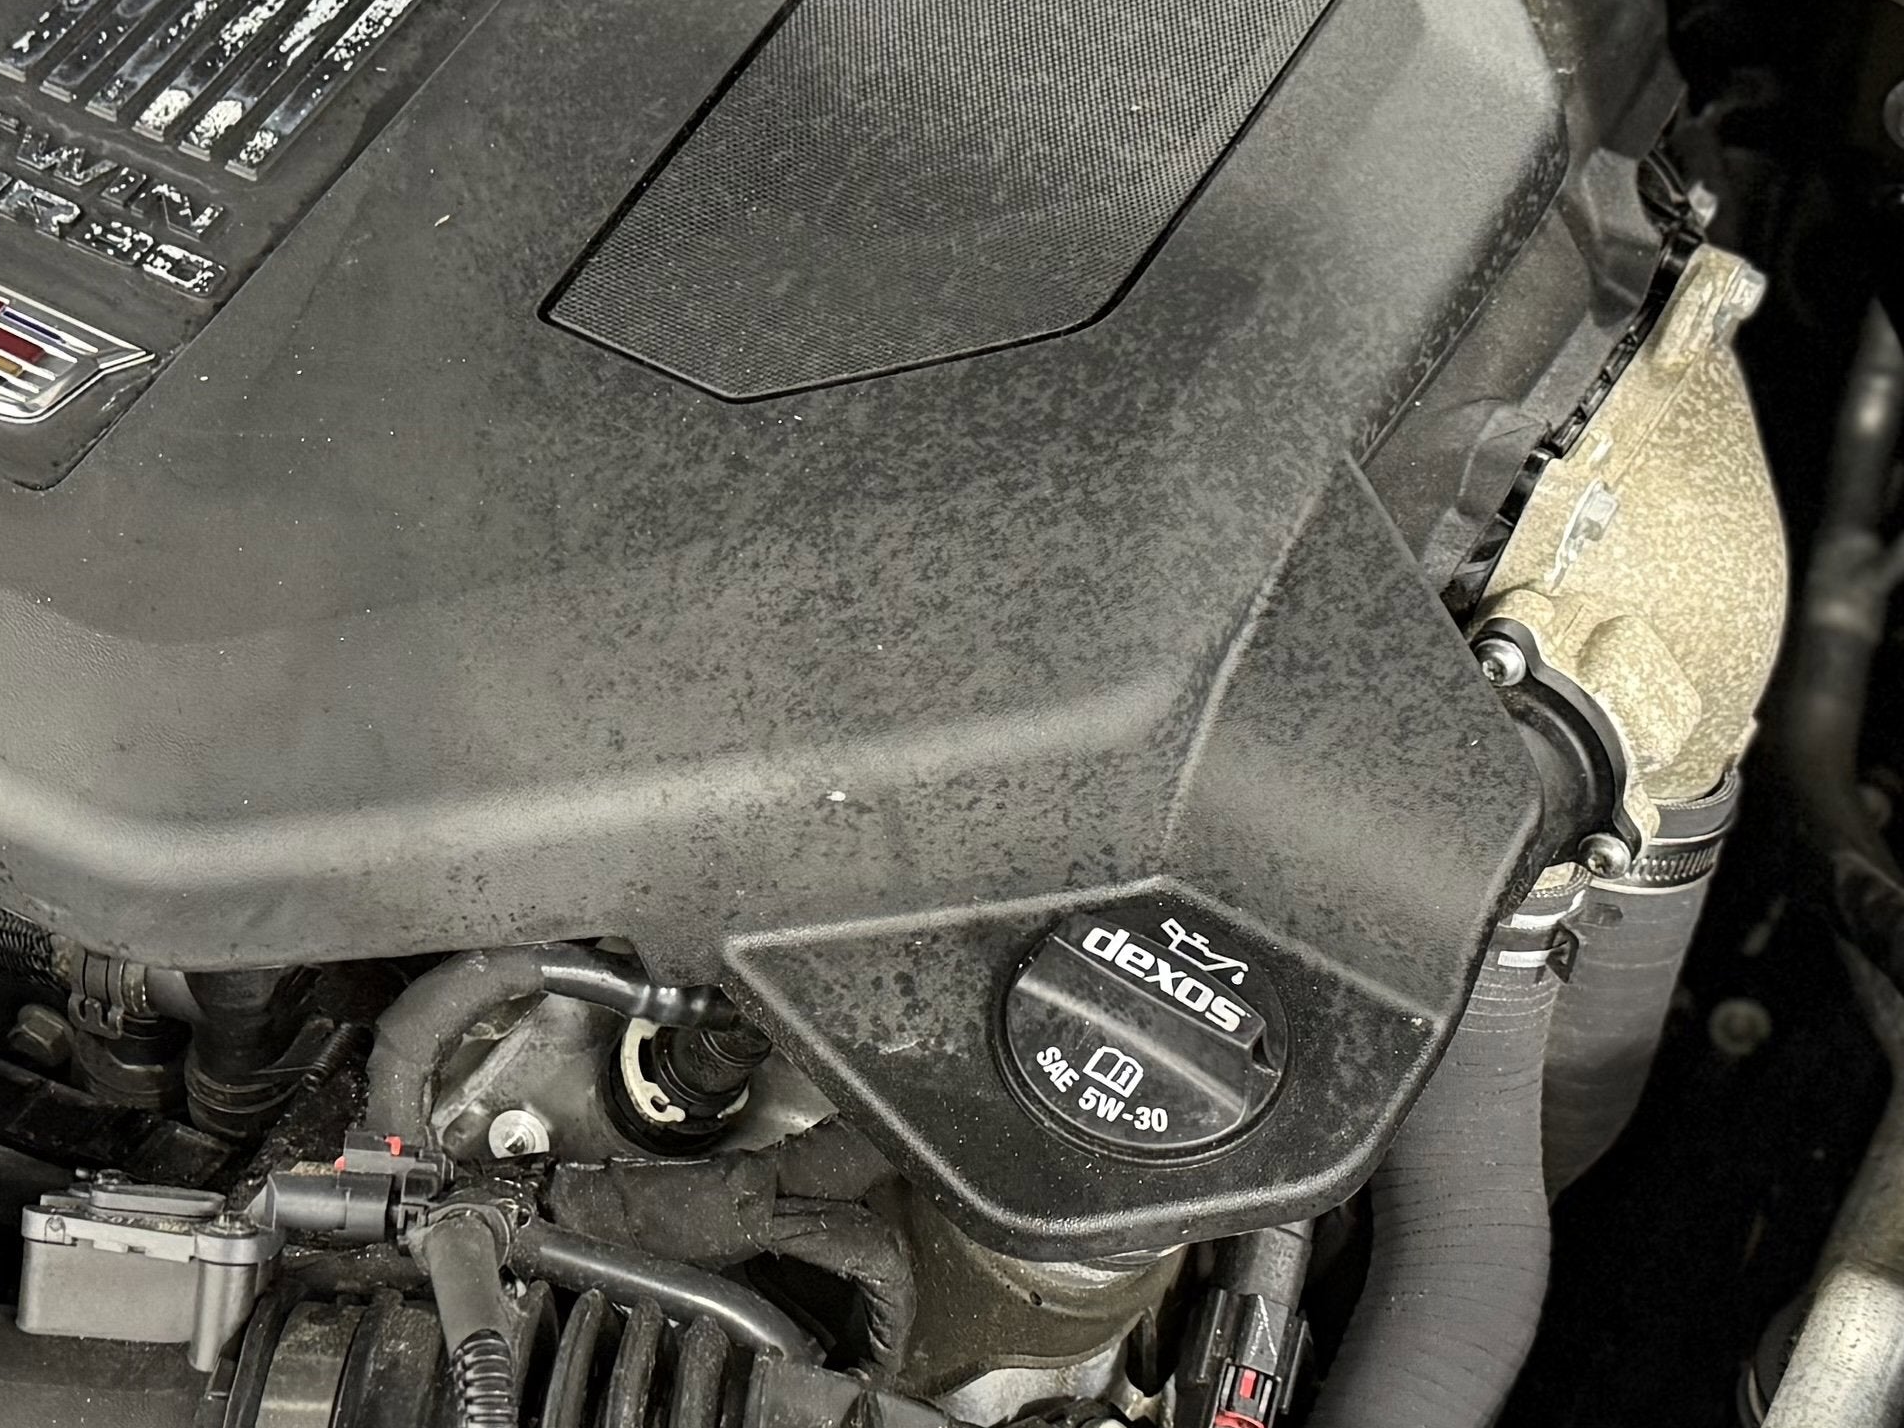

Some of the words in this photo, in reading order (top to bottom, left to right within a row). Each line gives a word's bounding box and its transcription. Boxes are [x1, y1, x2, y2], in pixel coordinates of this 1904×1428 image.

[1081, 927, 1245, 1033] dexos
[1036, 1045, 1080, 1093] SAE
[1078, 1086, 1169, 1133] 5W-30
